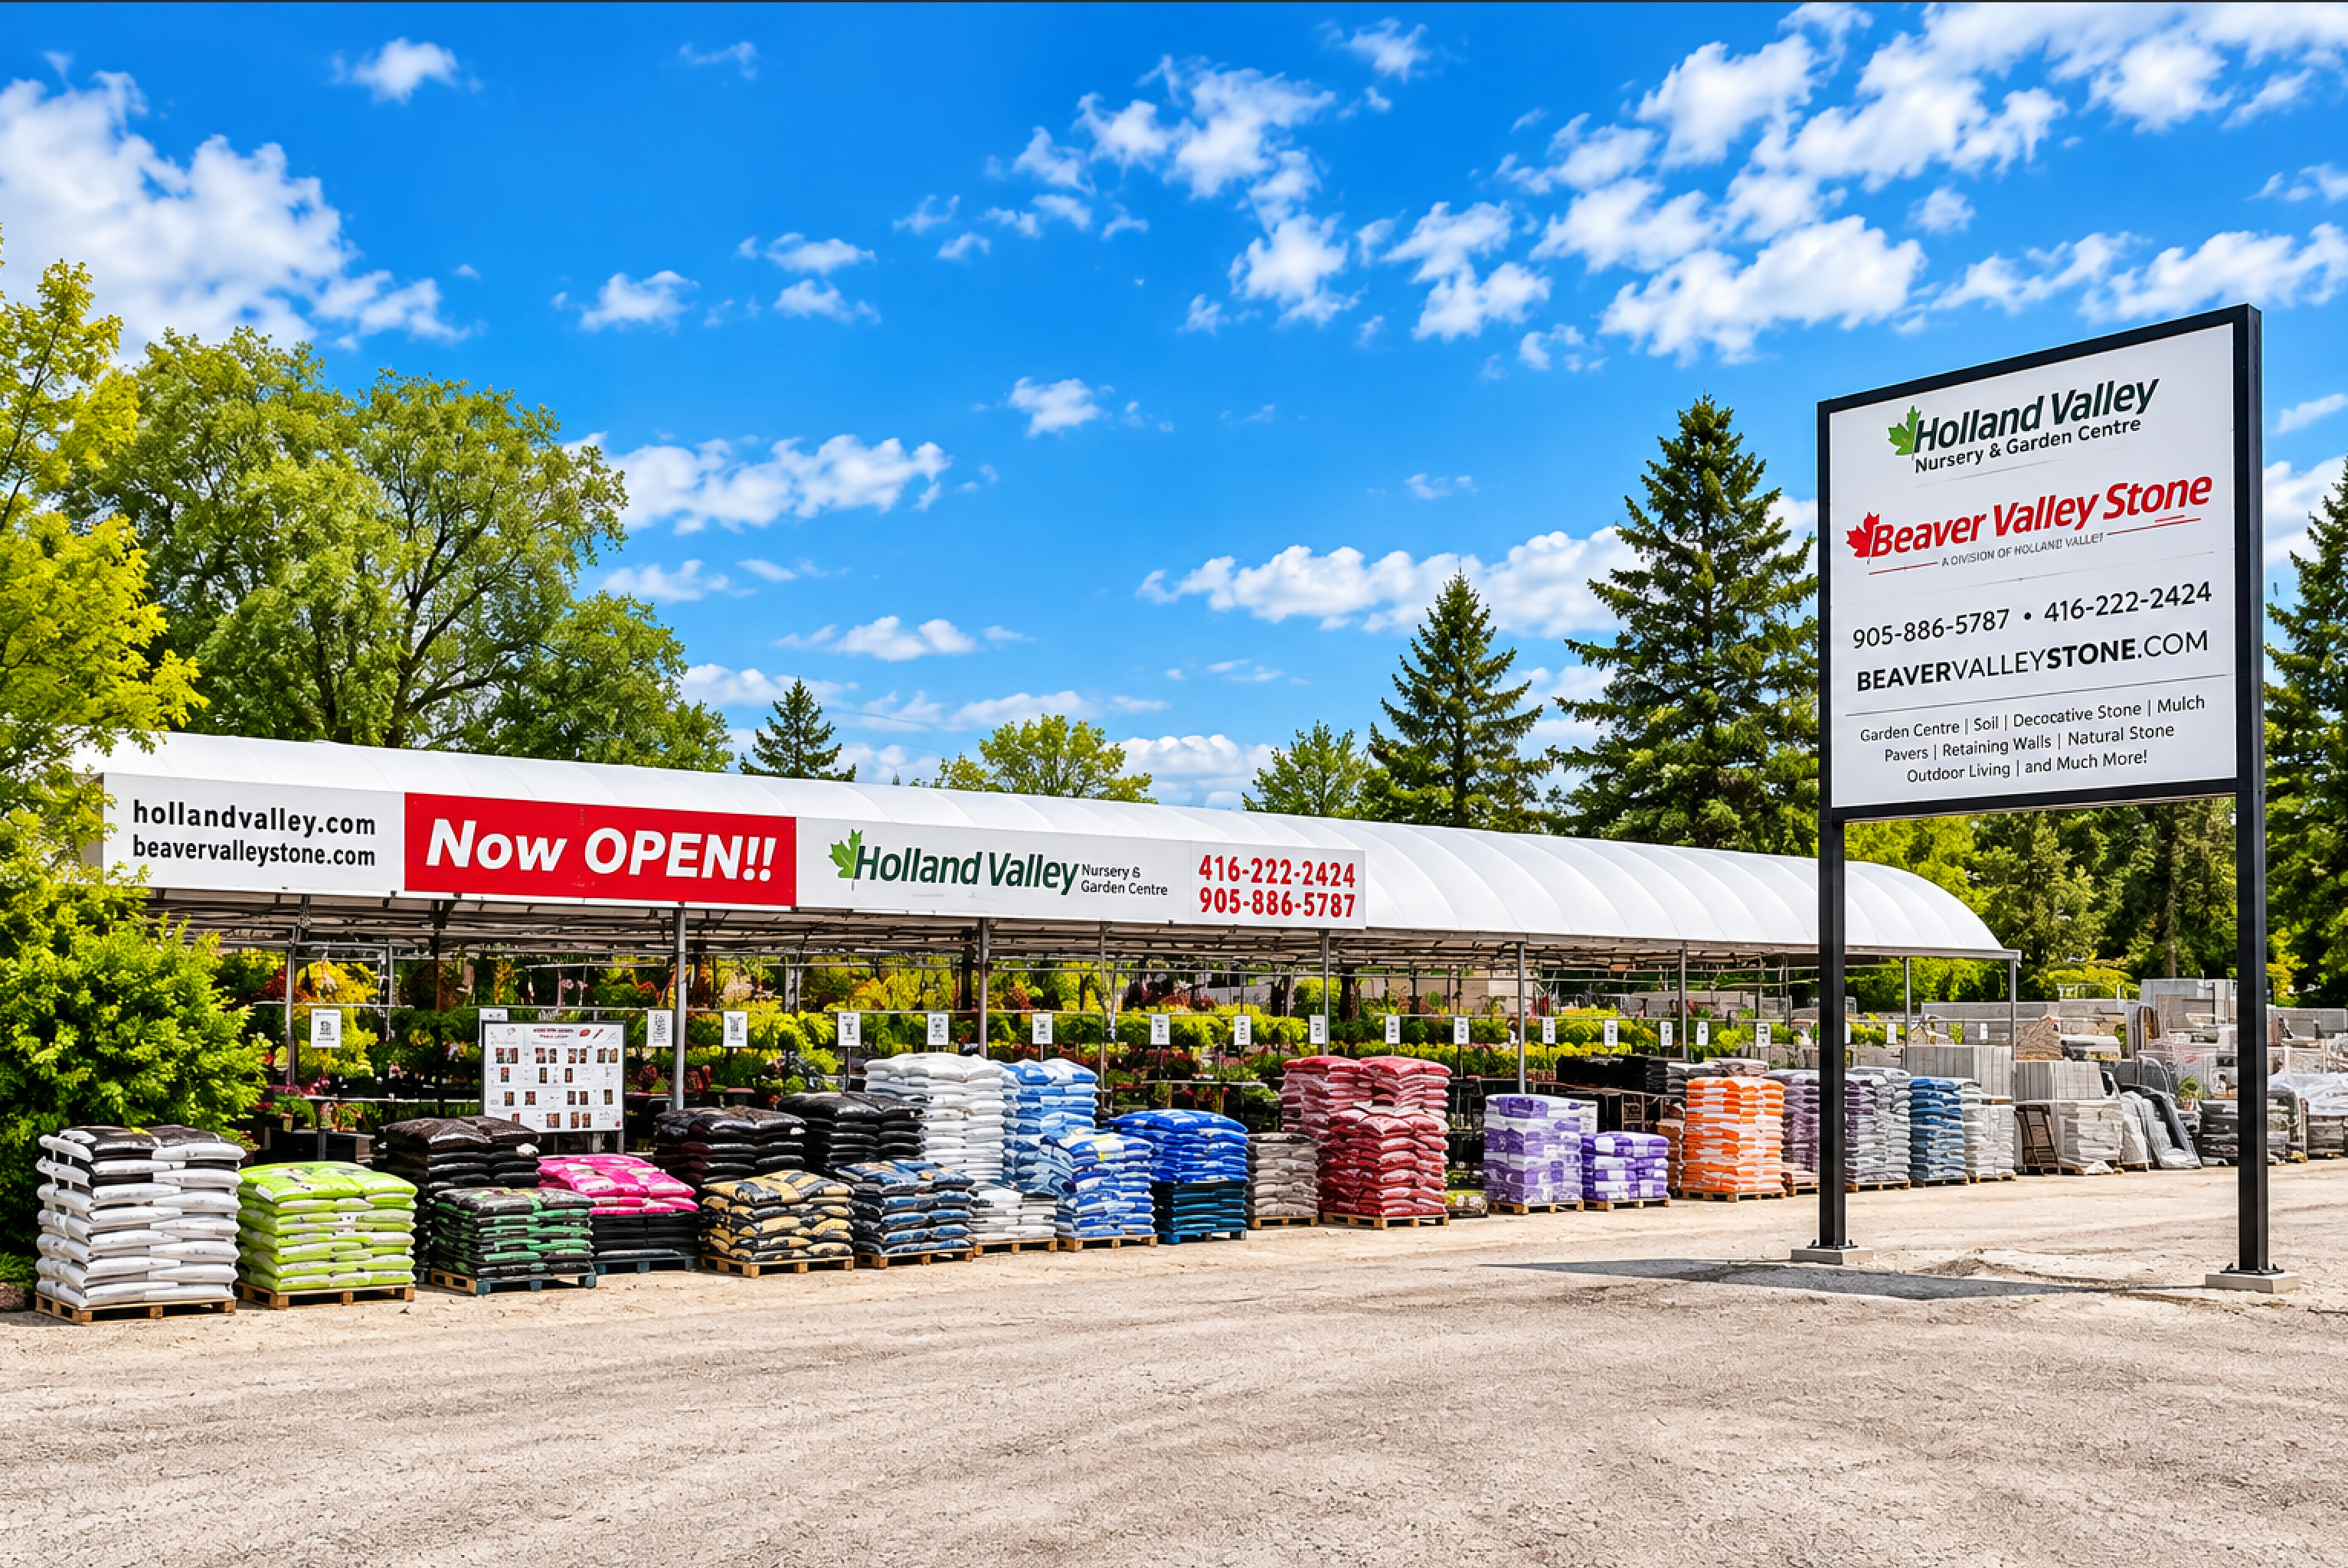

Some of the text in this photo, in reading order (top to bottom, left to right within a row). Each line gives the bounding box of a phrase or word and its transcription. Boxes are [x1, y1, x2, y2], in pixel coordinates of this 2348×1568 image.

[1915, 378, 2160, 452] Holland Valley
[1915, 420, 2140, 473] Nursery & Garden Centre
[1870, 475, 2212, 557] Beaver Valley Stone
[1997, 547, 2013, 559] OF
[2014, 538, 2062, 556] HOLLAND
[1853, 581, 2212, 649] 905-886-5787 416-222-2424
[1857, 630, 2208, 691] BEAVERVALLEYSTONE.COM
[1860, 727, 1909, 742] Garden
[1913, 723, 1960, 737] Centre
[1974, 715, 1999, 731] Soil
[2098, 704, 2142, 720] Stone
[2157, 694, 2205, 714] Mulch
[1885, 725, 2174, 762] Pavers Retaining Walls Natural Stone
[1907, 749, 2147, 782] Outdoor Living and Much More!
[133, 799, 375, 838] hollandvalley.com
[133, 834, 375, 867] beavervalleystone.com
[426, 818, 777, 882] Now OPEN!!
[853, 845, 1080, 896] Holland Valley
[1081, 864, 1130, 880] Nursery
[1081, 880, 1168, 896] Garden Centre
[1199, 854, 1356, 888] 416-222-2424
[1199, 887, 1356, 918] 905-886-5787
